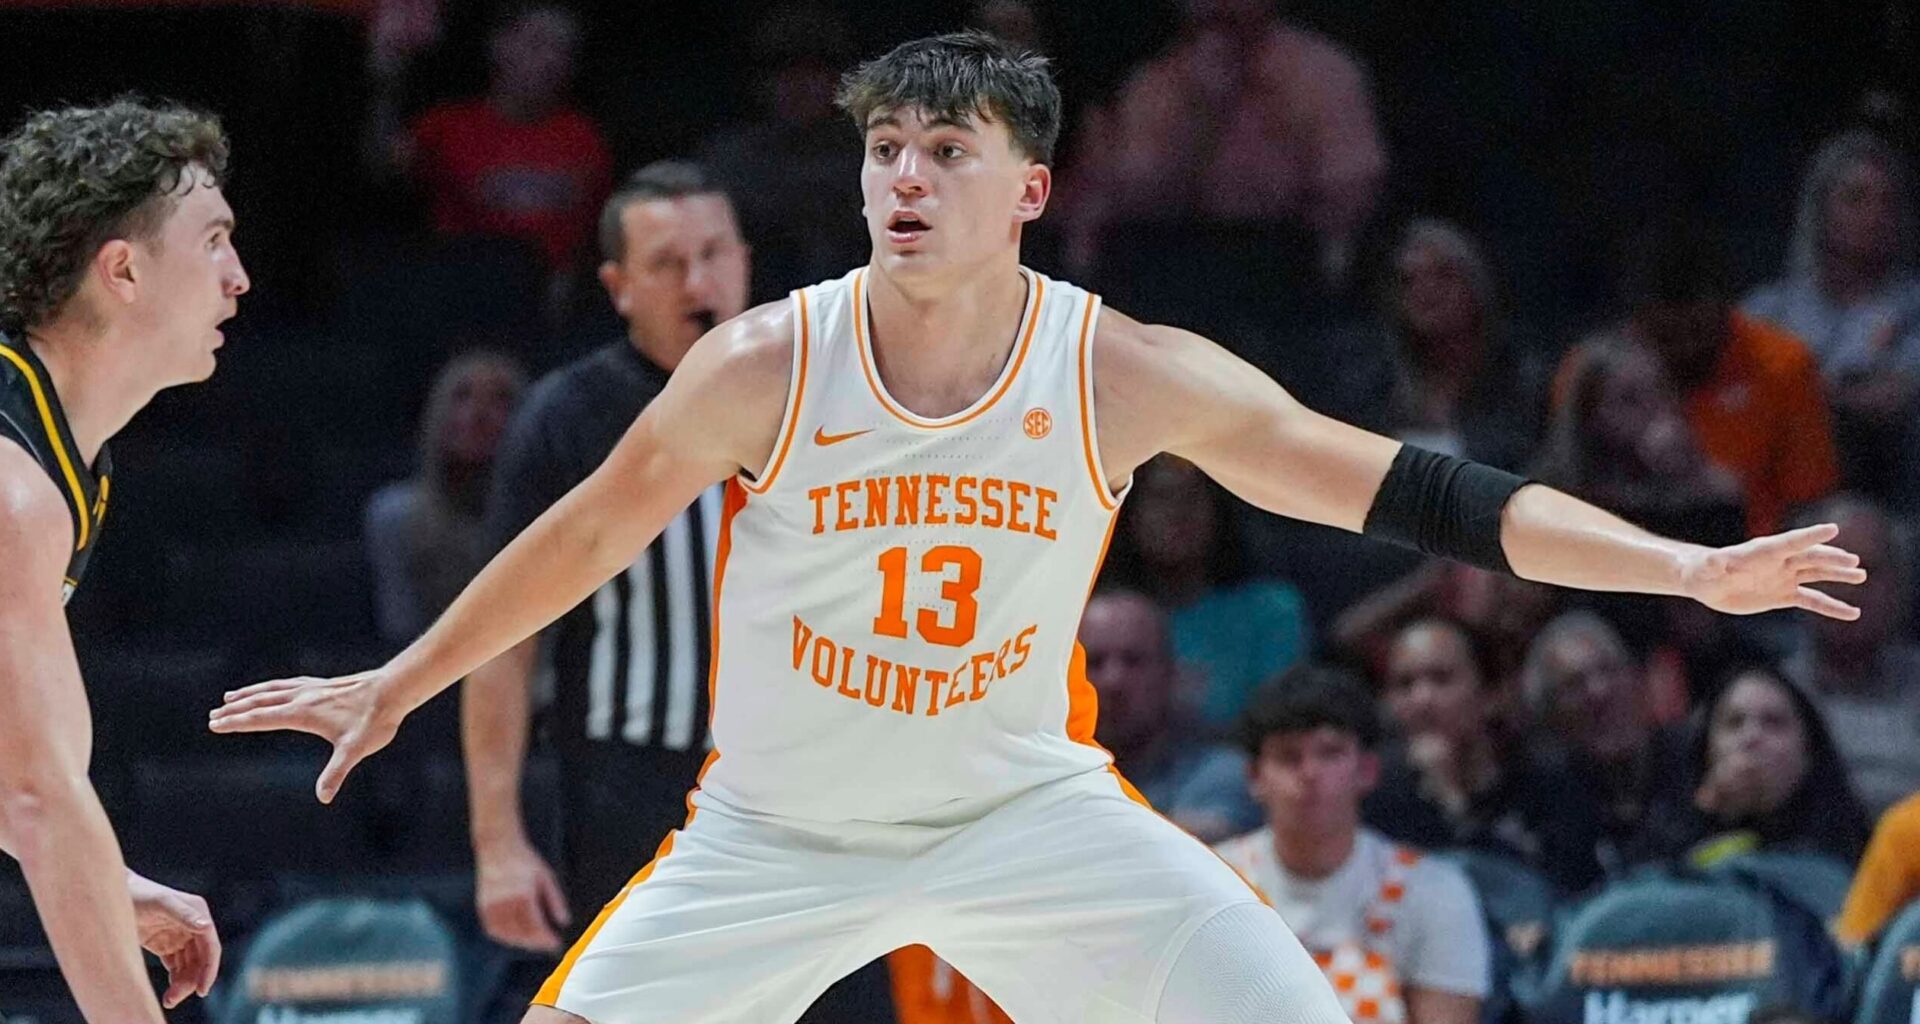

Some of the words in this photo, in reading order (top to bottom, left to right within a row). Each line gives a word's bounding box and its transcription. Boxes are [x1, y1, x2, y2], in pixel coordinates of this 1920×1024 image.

[1025, 411, 1051, 436] SEC
[808, 474, 1058, 541] TENNESSEE
[873, 545, 983, 648] 13
[792, 615, 1038, 717] VOLUNTEERS
